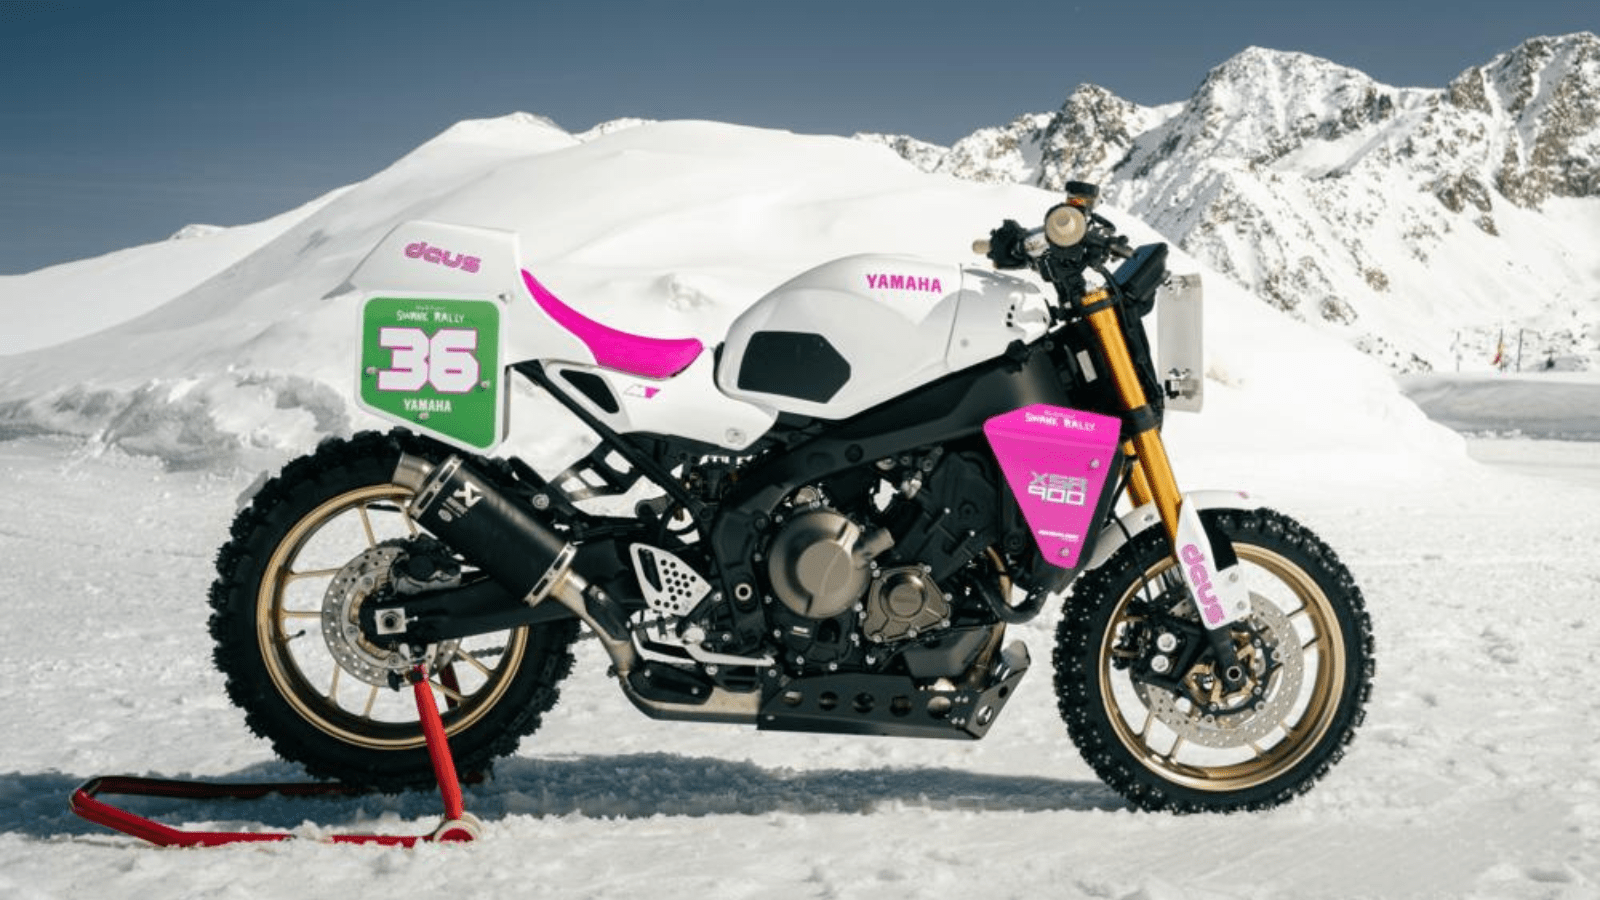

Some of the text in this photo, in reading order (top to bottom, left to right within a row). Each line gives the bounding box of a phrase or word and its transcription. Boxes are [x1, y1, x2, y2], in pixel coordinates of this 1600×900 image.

[866, 273, 942, 293] YAMAHA
[434, 312, 465, 323] RALLY
[377, 326, 481, 394] 36
[403, 399, 452, 412] YAMAHA
[1063, 418, 1095, 432] RALLY
[1030, 471, 1087, 492] XSR
[1028, 485, 1085, 506] 900
